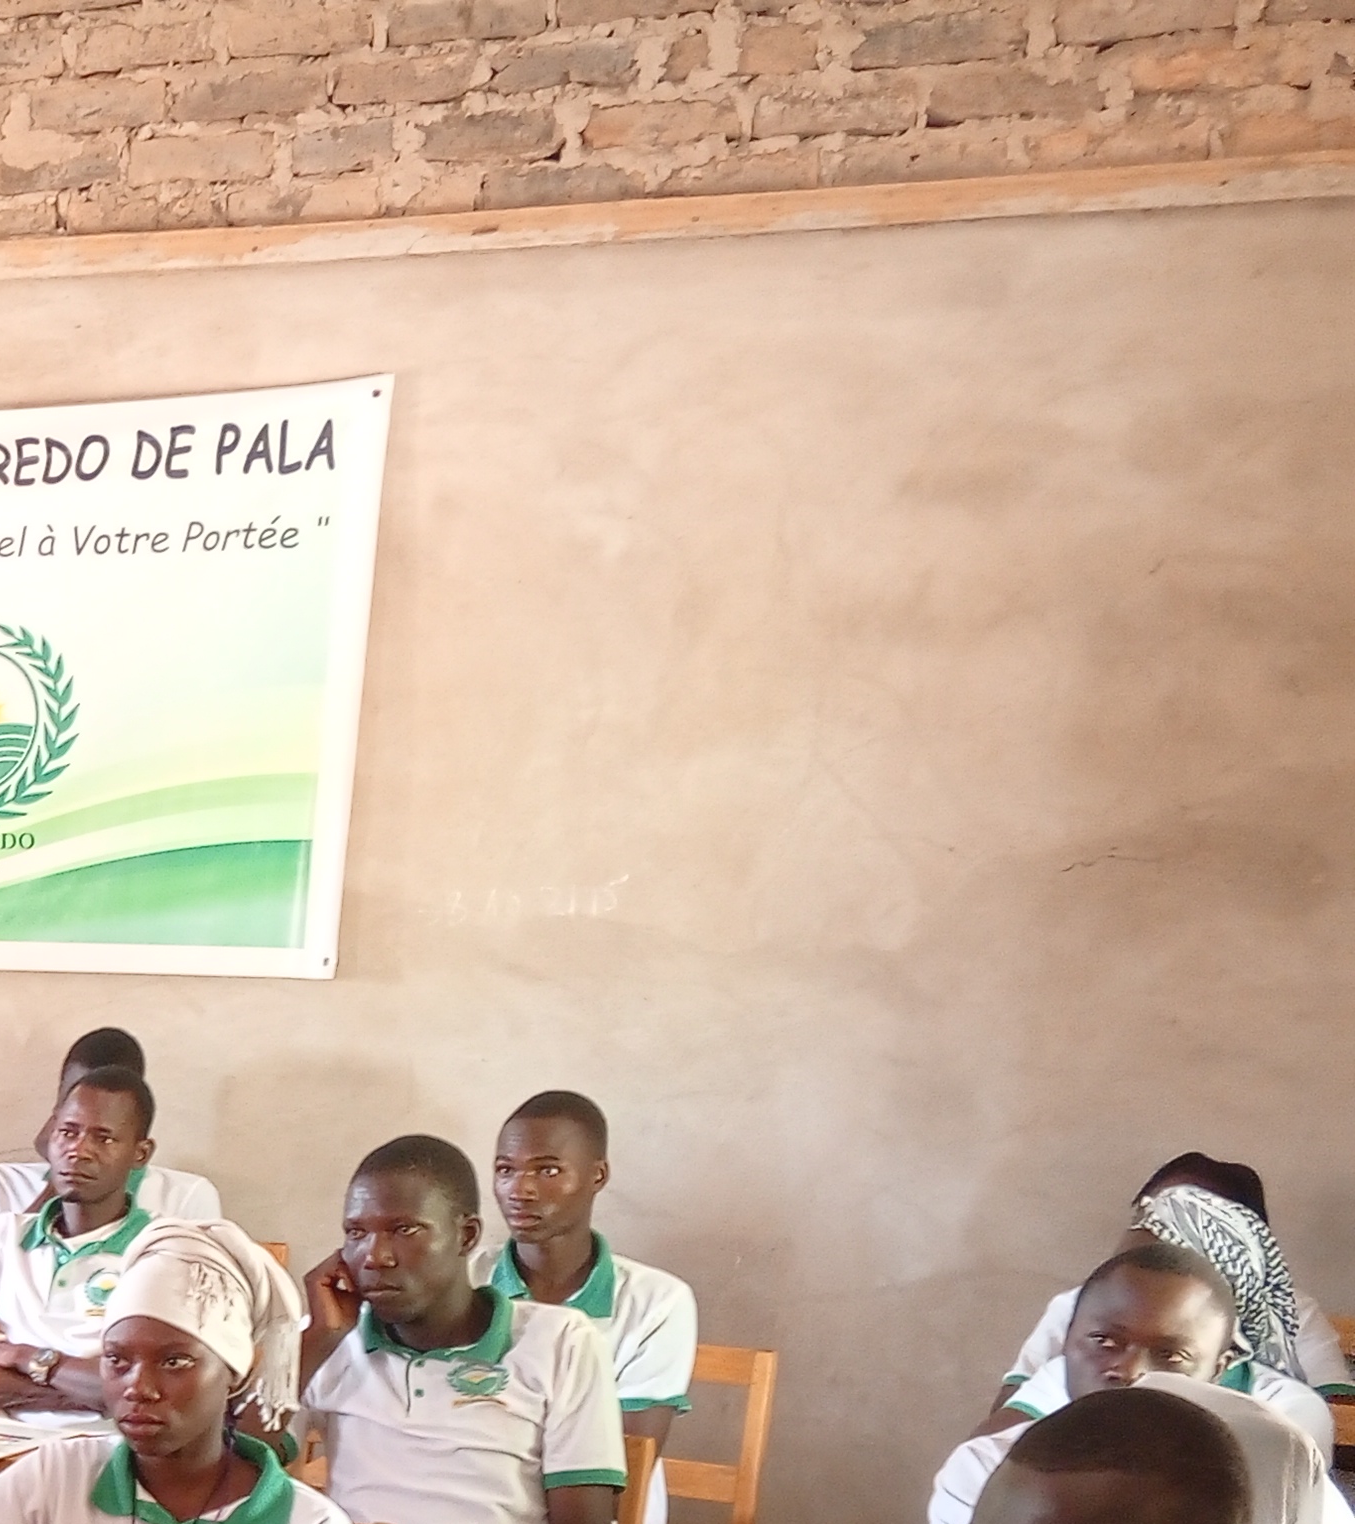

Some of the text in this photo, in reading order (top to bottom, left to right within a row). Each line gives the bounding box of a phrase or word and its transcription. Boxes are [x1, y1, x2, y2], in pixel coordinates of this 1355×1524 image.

[130, 423, 197, 481] DE
[214, 418, 336, 476] PALA
[37, 523, 56, 557] à
[73, 524, 171, 556] Votre
[181, 514, 300, 553] Portée
